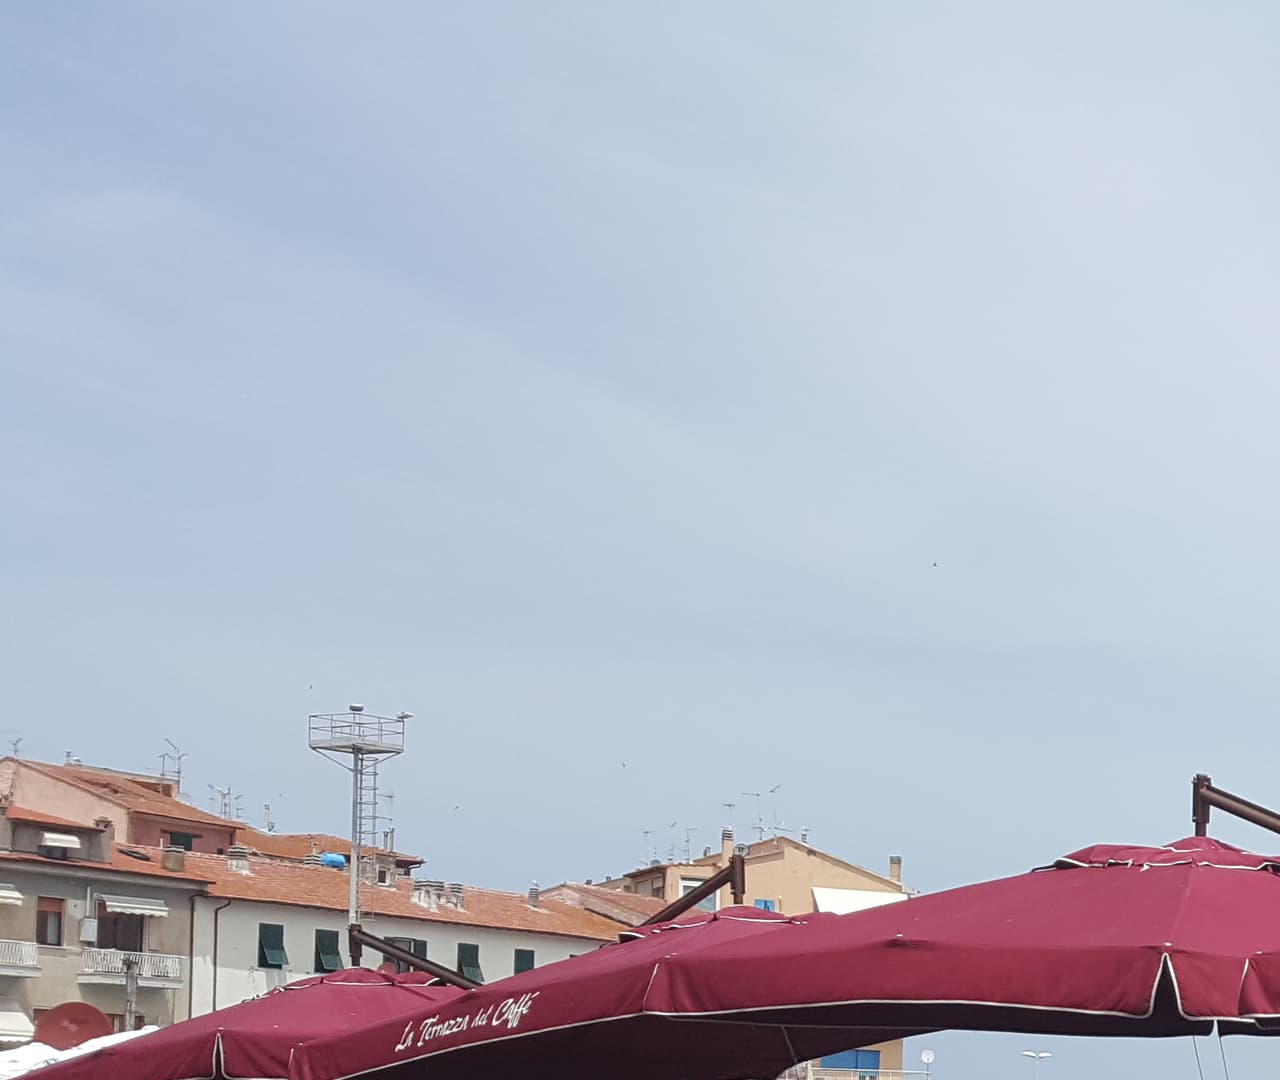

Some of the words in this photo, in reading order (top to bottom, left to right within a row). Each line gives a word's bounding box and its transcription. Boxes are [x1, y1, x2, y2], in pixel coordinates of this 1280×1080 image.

[394, 1020, 415, 1053] La
[416, 1014, 470, 1048] Terrazza
[470, 1004, 494, 1029] del
